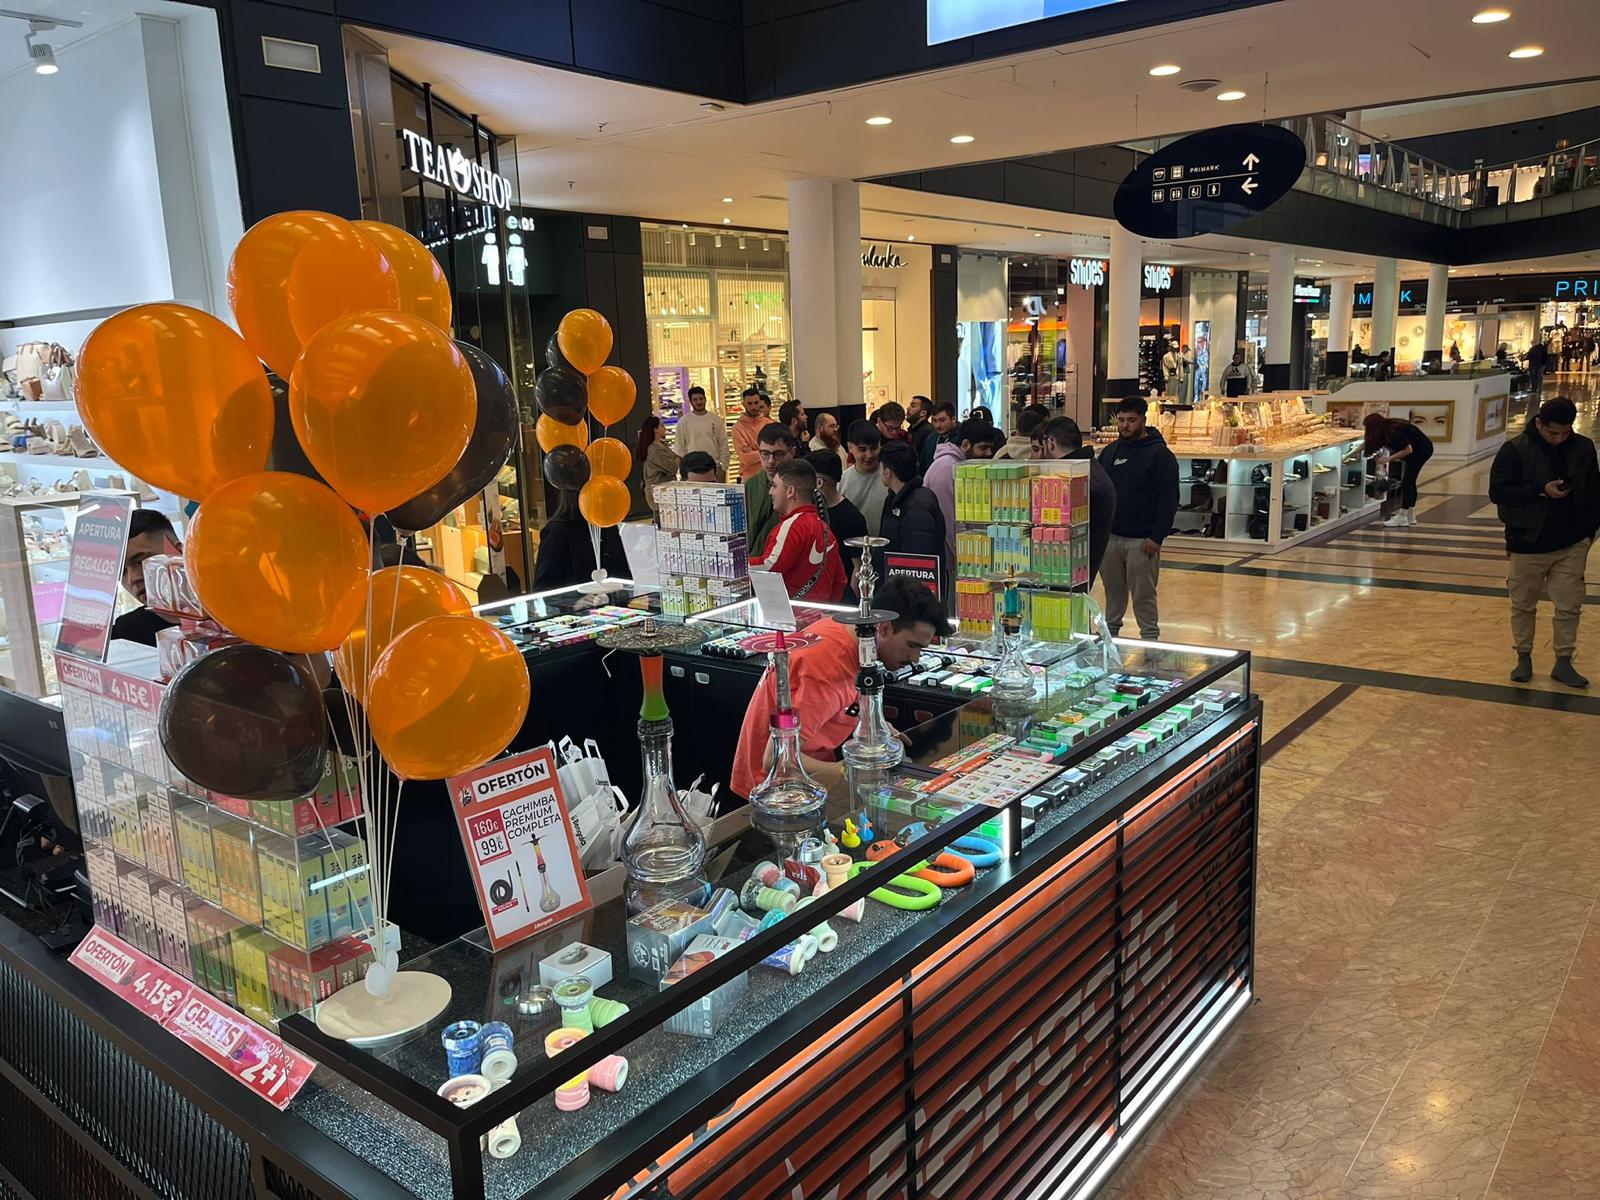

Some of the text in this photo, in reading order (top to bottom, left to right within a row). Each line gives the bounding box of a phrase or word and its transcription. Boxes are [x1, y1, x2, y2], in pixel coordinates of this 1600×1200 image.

[403, 128, 513, 211] TEA SHOP
[1189, 164, 1220, 174] PRIMARK
[1070, 258, 1105, 291] snipes
[1144, 264, 1172, 293] snipes
[78, 522, 122, 541] APERTURA
[73, 555, 116, 576] REGALOS
[477, 763, 545, 795] OFERTÓN
[502, 794, 556, 820] CACHIMBA
[505, 805, 553, 831] PREMIUM
[507, 815, 562, 840] COMPLETA
[84, 939, 130, 975] OFERTÓN
[132, 972, 183, 1014] 4x15€
[184, 1001, 241, 1048] GRATIS
[240, 1049, 290, 1097] 2+1
